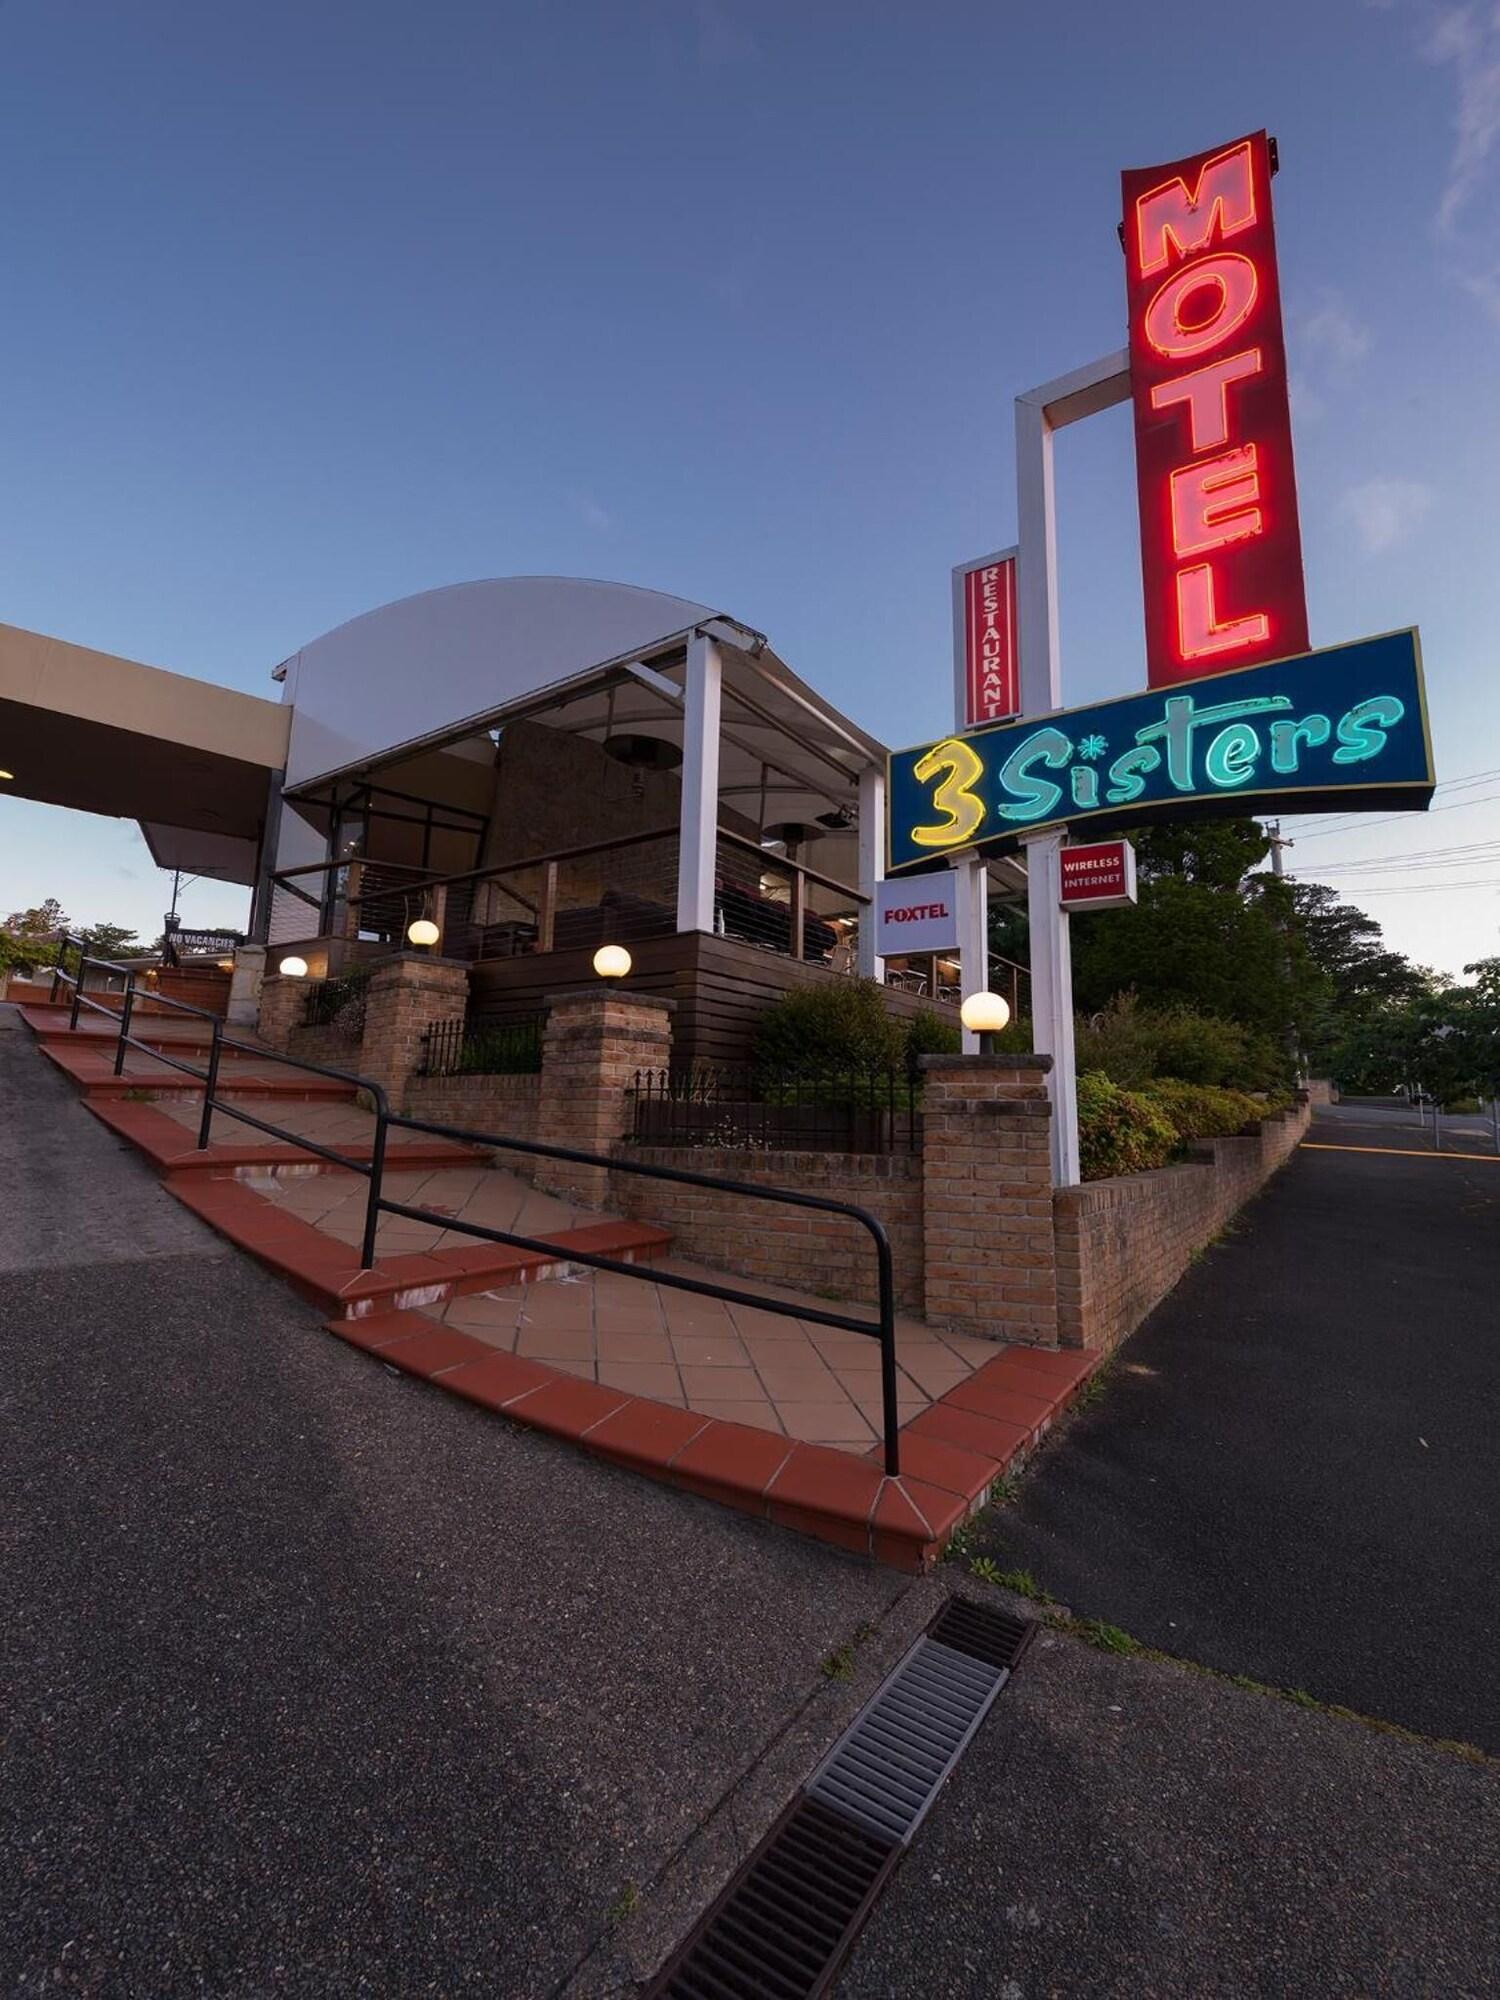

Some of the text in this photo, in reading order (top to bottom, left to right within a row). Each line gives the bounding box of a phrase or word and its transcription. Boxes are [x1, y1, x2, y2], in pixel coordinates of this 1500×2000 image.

[1136, 141, 1269, 660] MOTEL
[981, 567, 1001, 718] RESTAURANT
[910, 696, 1405, 847] 3 Sisters
[1064, 856, 1120, 872] WIRELESS
[1064, 873, 1120, 888] INTERNET
[884, 903, 949, 924] FOXTEL
[169, 933, 234, 949] NO VACANCIES
